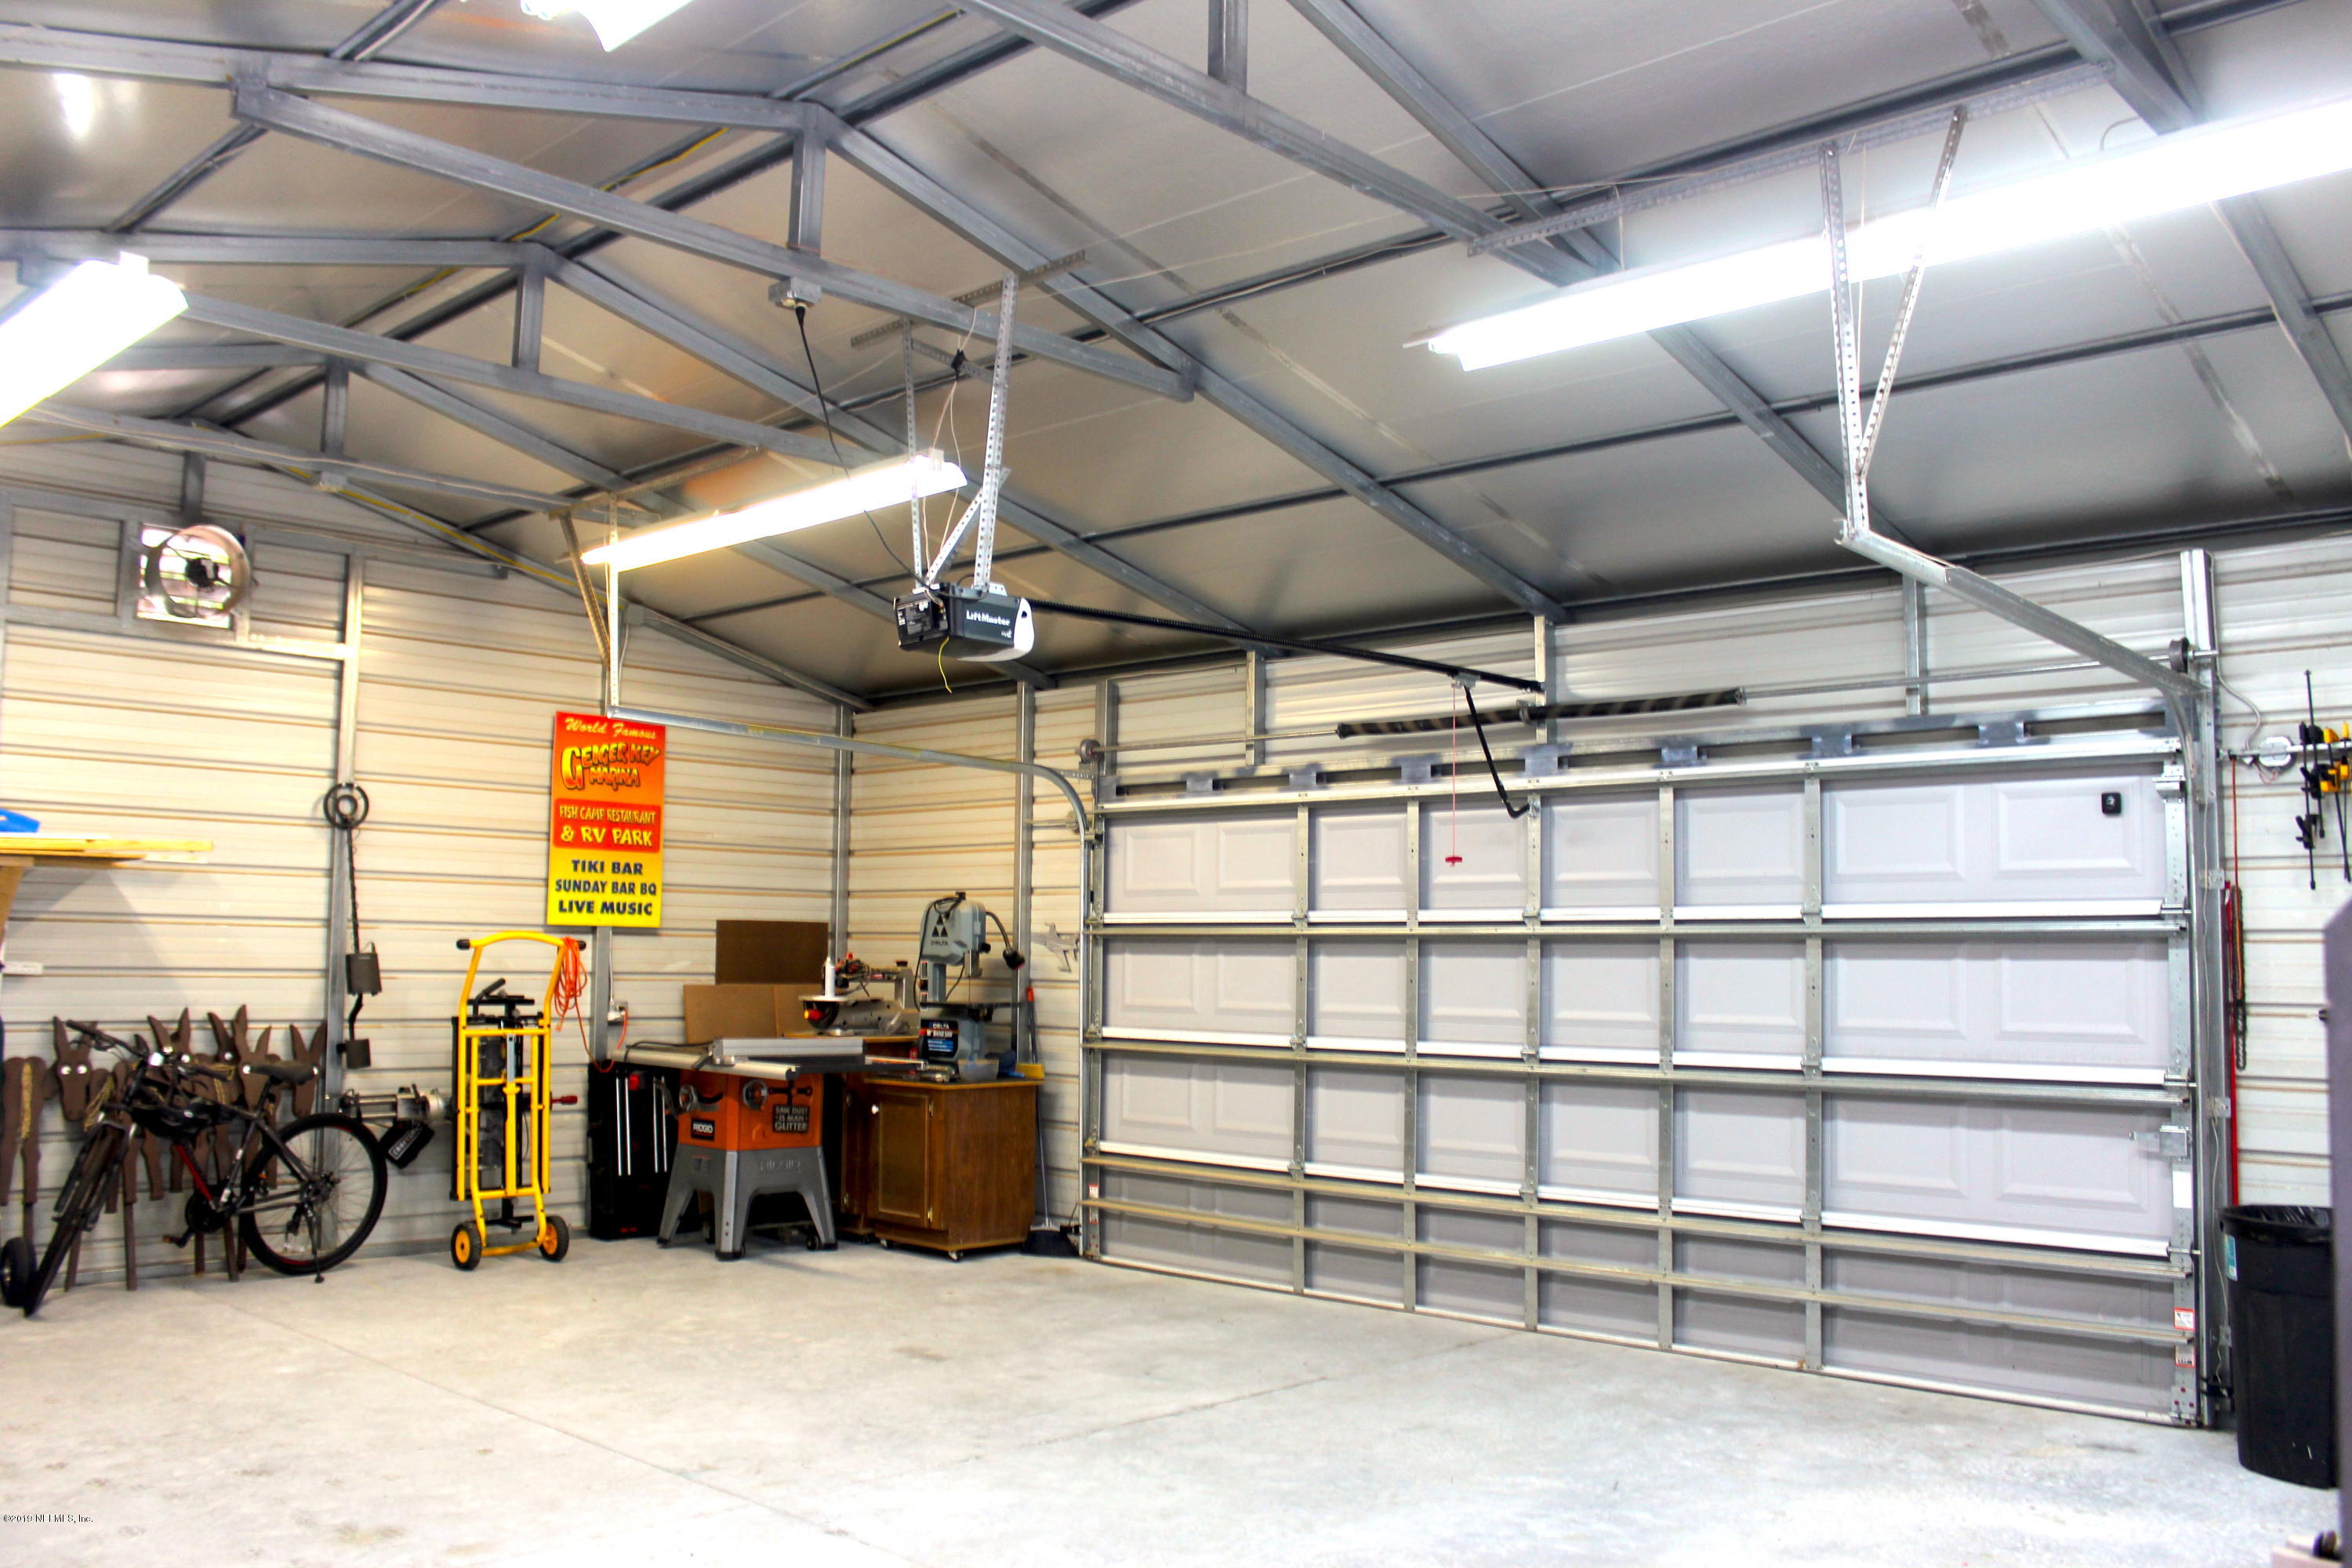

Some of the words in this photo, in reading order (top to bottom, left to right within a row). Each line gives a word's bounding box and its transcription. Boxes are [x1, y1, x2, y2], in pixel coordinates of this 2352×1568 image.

[966, 610, 1011, 626] LiftMaster
[564, 717, 607, 734] World
[612, 722, 657, 739] Famous
[561, 742, 628, 790] GEIGER
[630, 743, 661, 766] KEY
[590, 766, 641, 791] MARINA
[559, 805, 578, 819] FISH
[580, 807, 604, 821] CAMP
[606, 808, 656, 824] RESTAURANT
[561, 826, 575, 842] &
[580, 826, 606, 844] RV
[612, 828, 652, 847] PARK
[572, 859, 604, 873] TIKI
[612, 862, 643, 875] BAR
[555, 879, 607, 893] SUNDAY
[612, 881, 635, 895] BAR
[640, 883, 657, 895] BQ
[558, 900, 594, 913] LIVE
[600, 902, 652, 916] MUSIC
[692, 1123, 713, 1134] RIDGID
[775, 1122, 808, 1131] GLITTER
